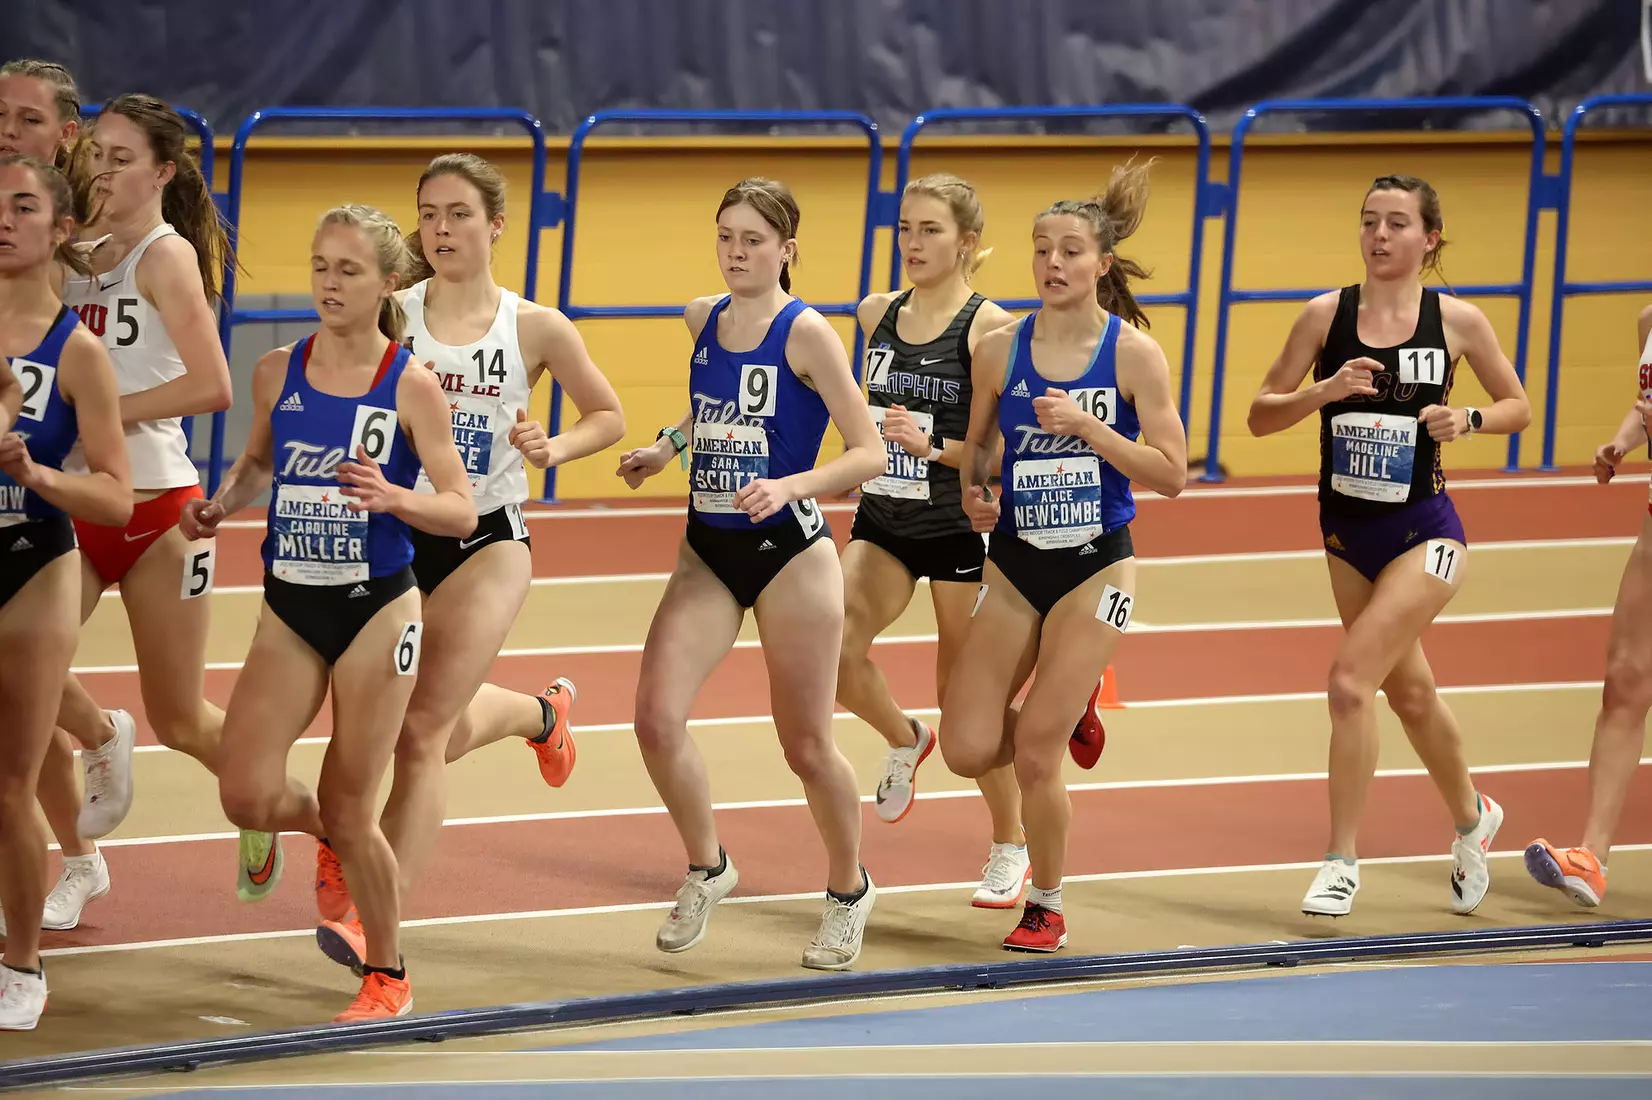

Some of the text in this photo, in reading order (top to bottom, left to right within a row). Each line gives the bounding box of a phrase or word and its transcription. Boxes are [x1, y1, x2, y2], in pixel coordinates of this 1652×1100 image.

[116, 299, 139, 346] 5
[472, 349, 507, 383] 14
[866, 350, 887, 382] 17
[1407, 350, 1435, 382] 11
[747, 368, 769, 413] 9
[1011, 390, 1031, 398] adidas
[280, 404, 304, 412] adidas
[1076, 390, 1108, 423] 16
[361, 411, 388, 459] 6
[695, 438, 763, 455] AMERICAN
[1336, 424, 1410, 444] AMERICAN
[1345, 440, 1400, 458] MADELINE
[711, 457, 740, 470] SARA
[1349, 453, 1392, 480] HILL
[1016, 471, 1095, 489] AMERICAN
[1041, 489, 1074, 503] ALICE
[279, 500, 362, 520] AMERICAN
[1014, 500, 1101, 528] NEWCOMBE
[290, 520, 349, 536] CAROLINE
[278, 534, 364, 561] MILLER
[190, 550, 210, 596] 5
[1435, 544, 1455, 580] 11
[1106, 591, 1131, 628] 16
[399, 624, 416, 672] 6
